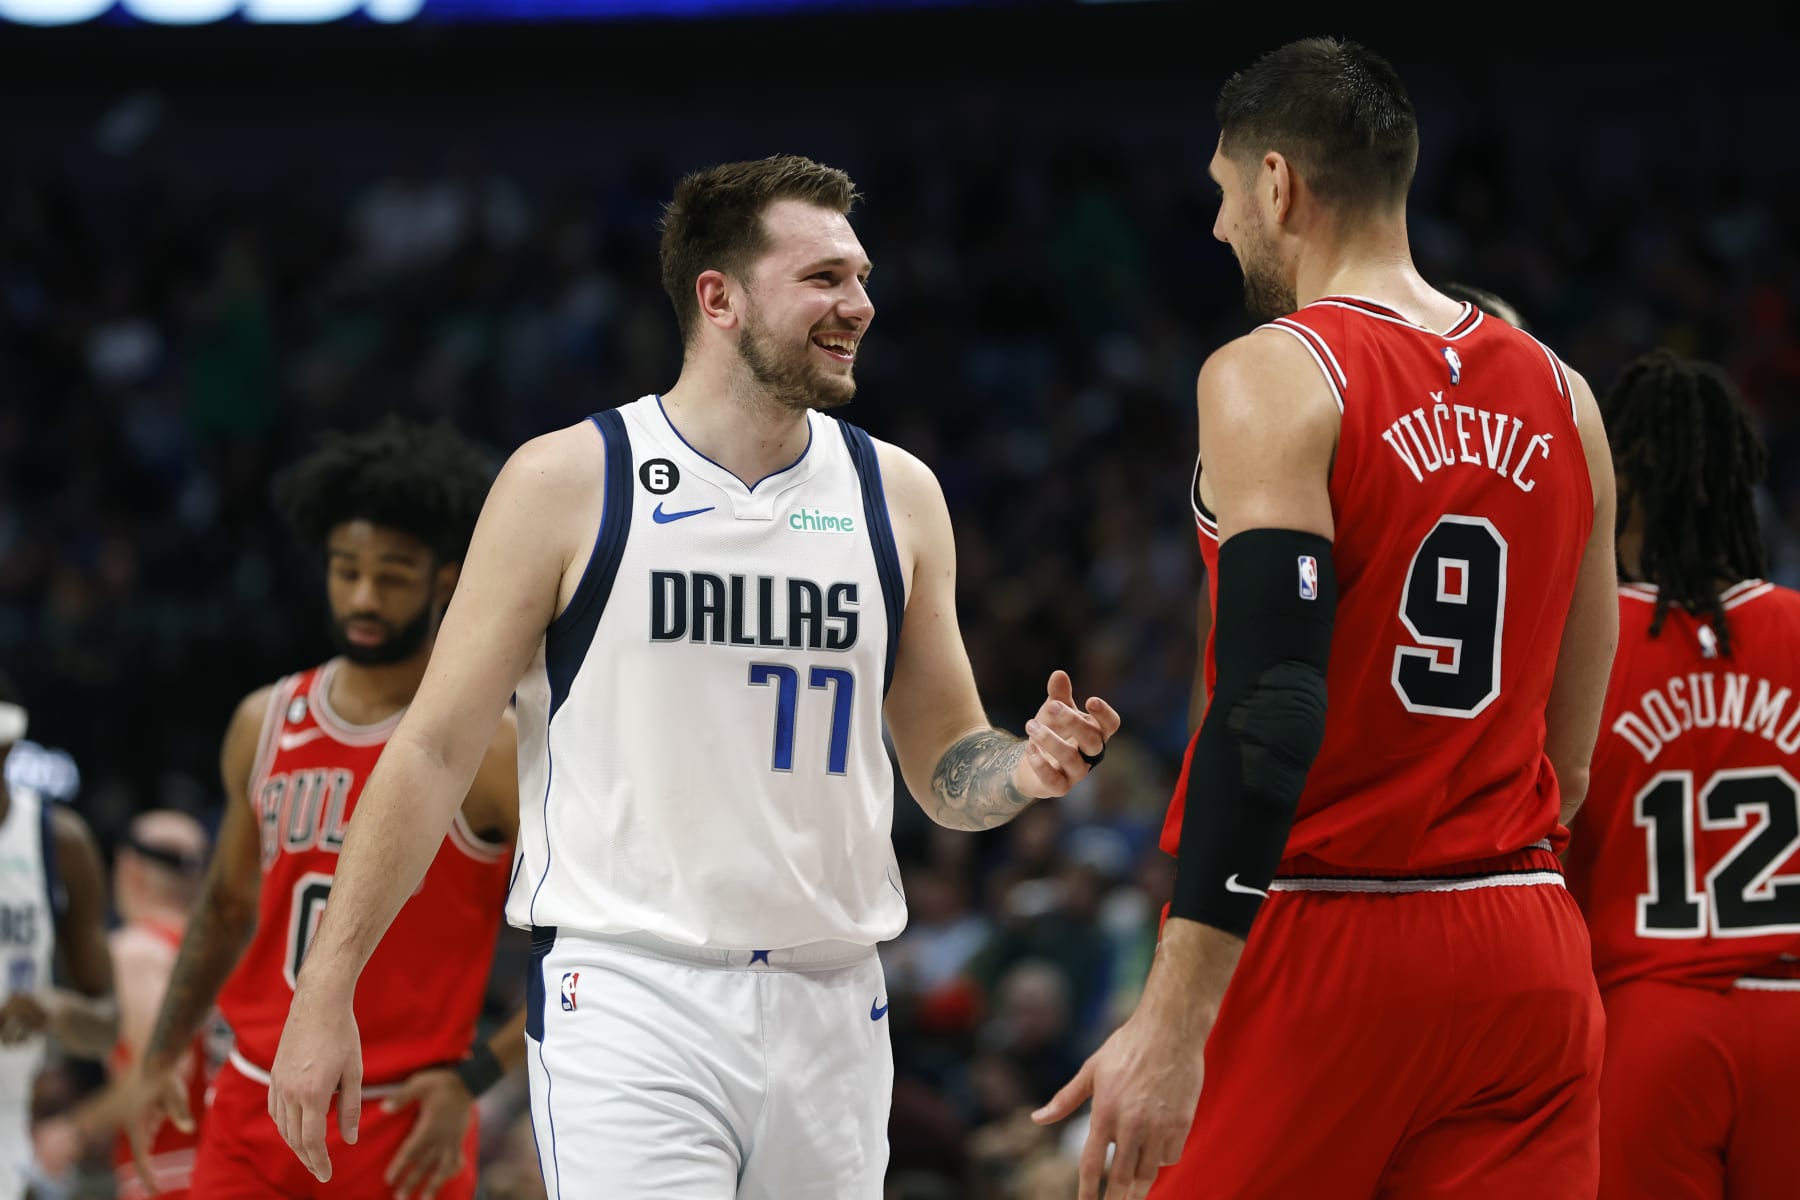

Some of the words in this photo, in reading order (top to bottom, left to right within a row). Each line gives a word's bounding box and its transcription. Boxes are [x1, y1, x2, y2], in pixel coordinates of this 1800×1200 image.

[649, 464, 669, 490] 6
[1382, 391, 1553, 492] VUČEVIĆ
[789, 508, 854, 532] chime
[649, 569, 860, 653] DALLAS
[1391, 514, 1508, 719] 9
[747, 661, 856, 776] 77
[257, 767, 354, 873] BUL
[1634, 766, 1800, 938] 12
